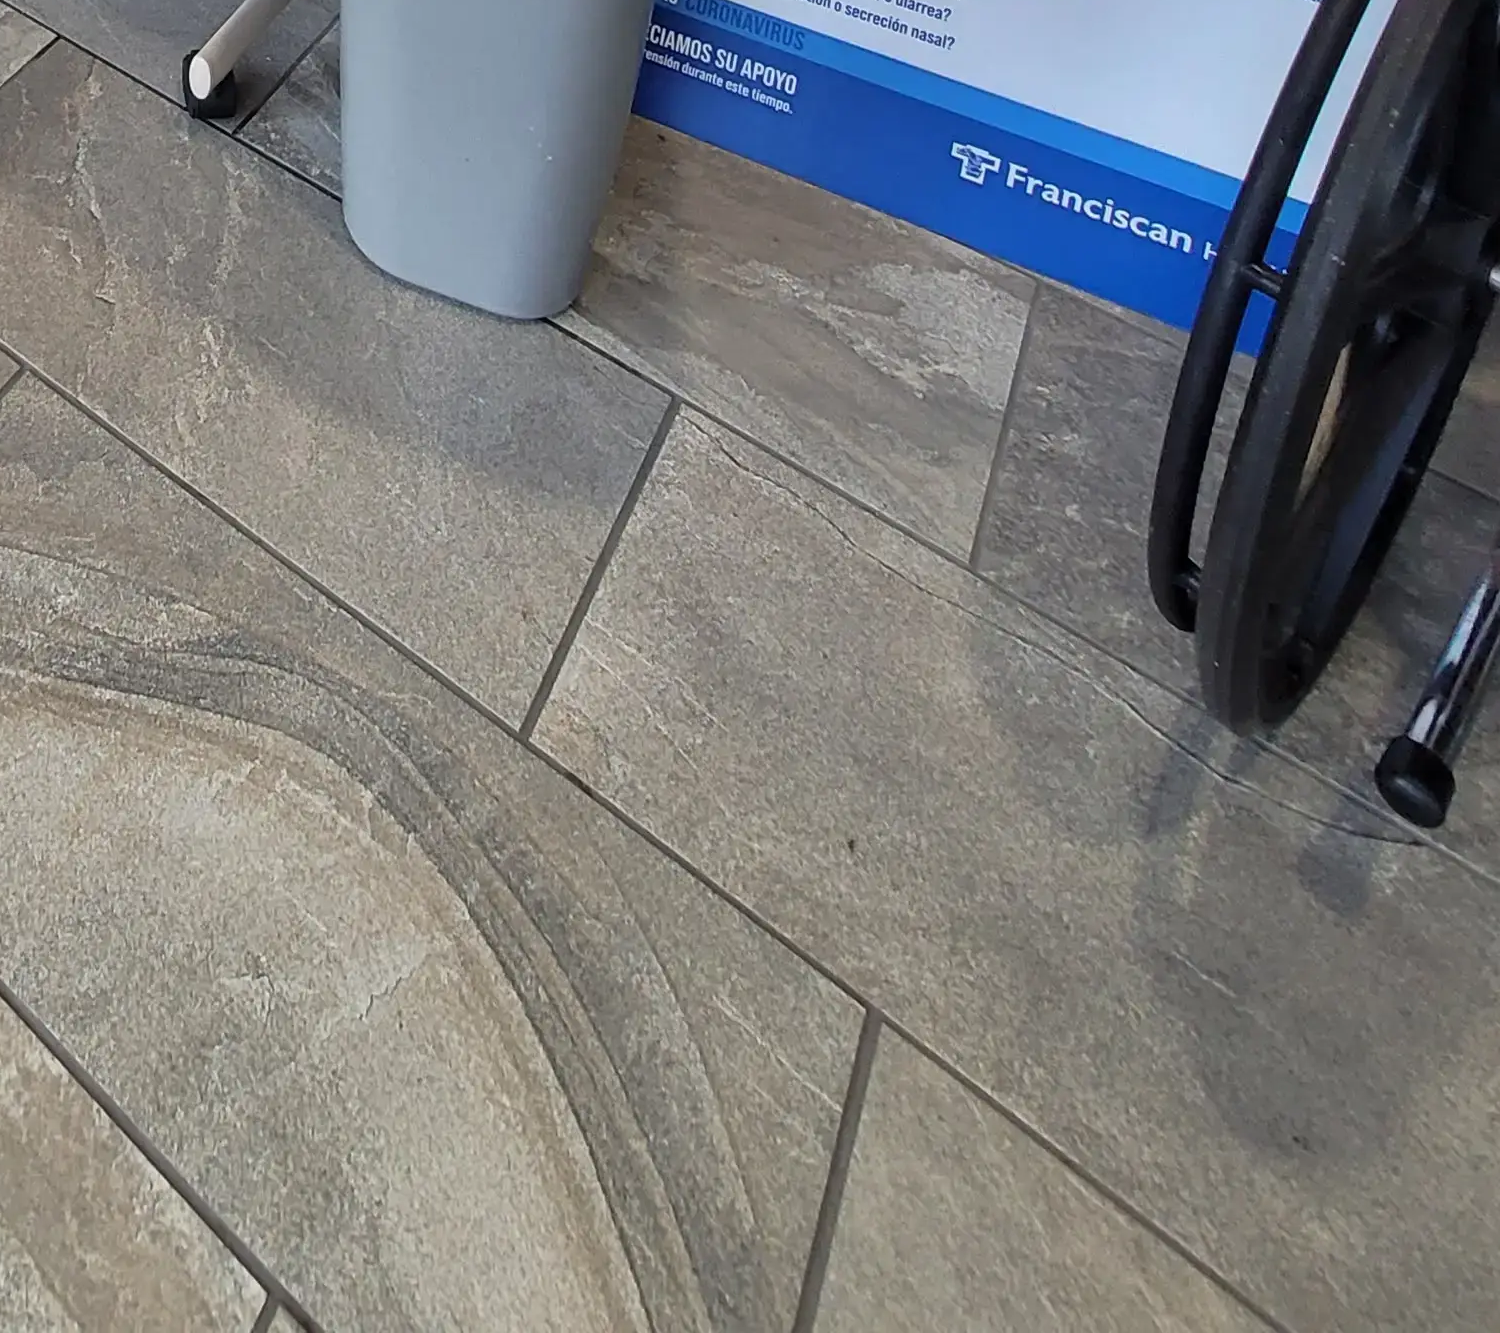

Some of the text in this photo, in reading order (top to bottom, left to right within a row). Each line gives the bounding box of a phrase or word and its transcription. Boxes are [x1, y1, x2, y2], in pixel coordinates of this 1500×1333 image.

[834, 1, 841, 11] o
[845, 5, 907, 34] secreción
[911, 27, 954, 49] nasal?
[715, 49, 737, 72] SU
[740, 59, 796, 94] APOYO
[1006, 162, 1191, 252] Franciscan
